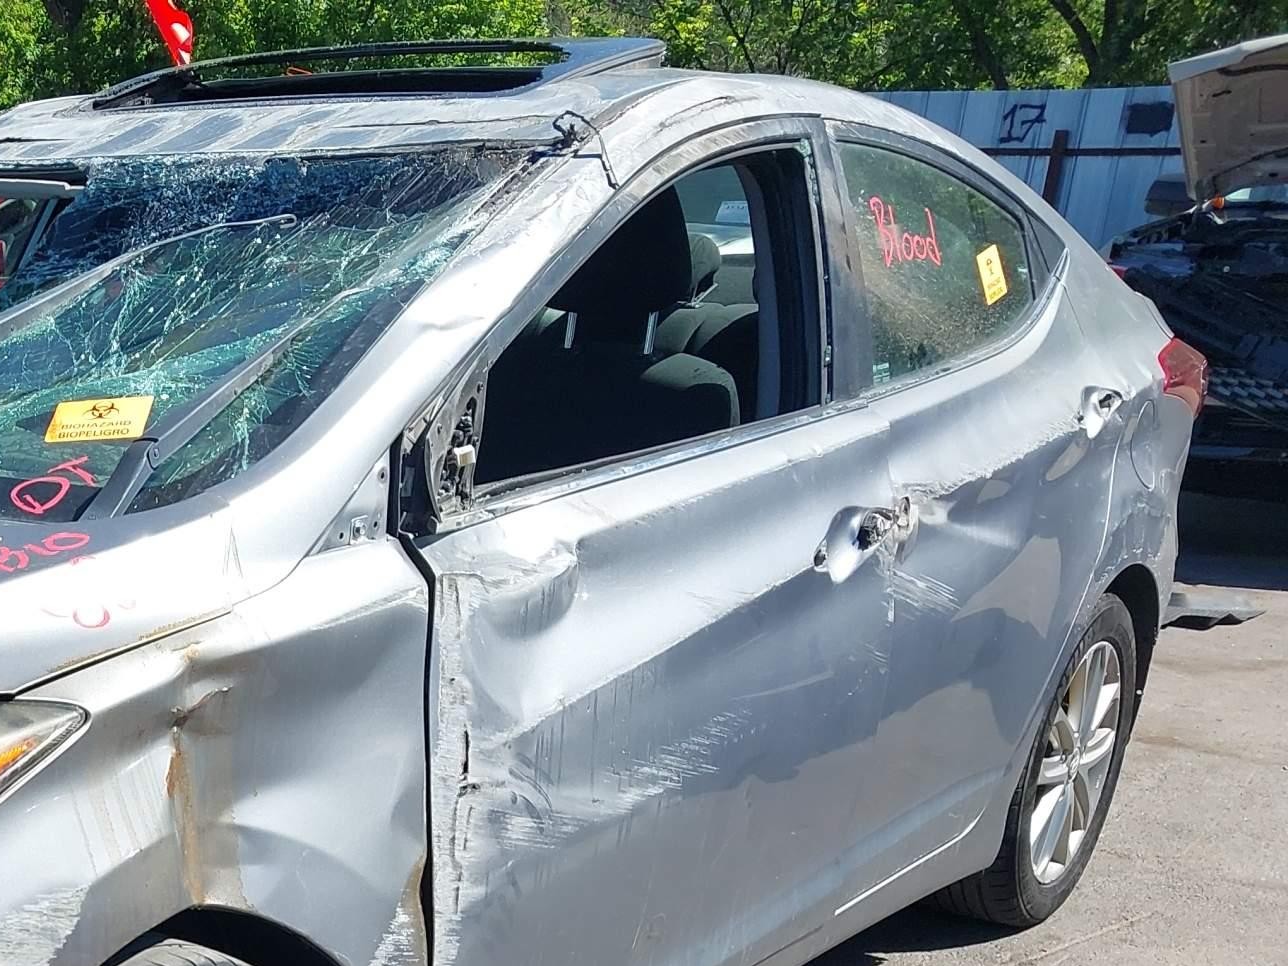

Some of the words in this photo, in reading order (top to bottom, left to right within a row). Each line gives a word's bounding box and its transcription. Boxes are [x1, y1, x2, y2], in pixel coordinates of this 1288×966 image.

[999, 104, 1047, 144] 17
[869, 196, 942, 267] Blood
[58, 428, 130, 439] BIOPELIGRO
[61, 420, 132, 430] BIOHAZARD
